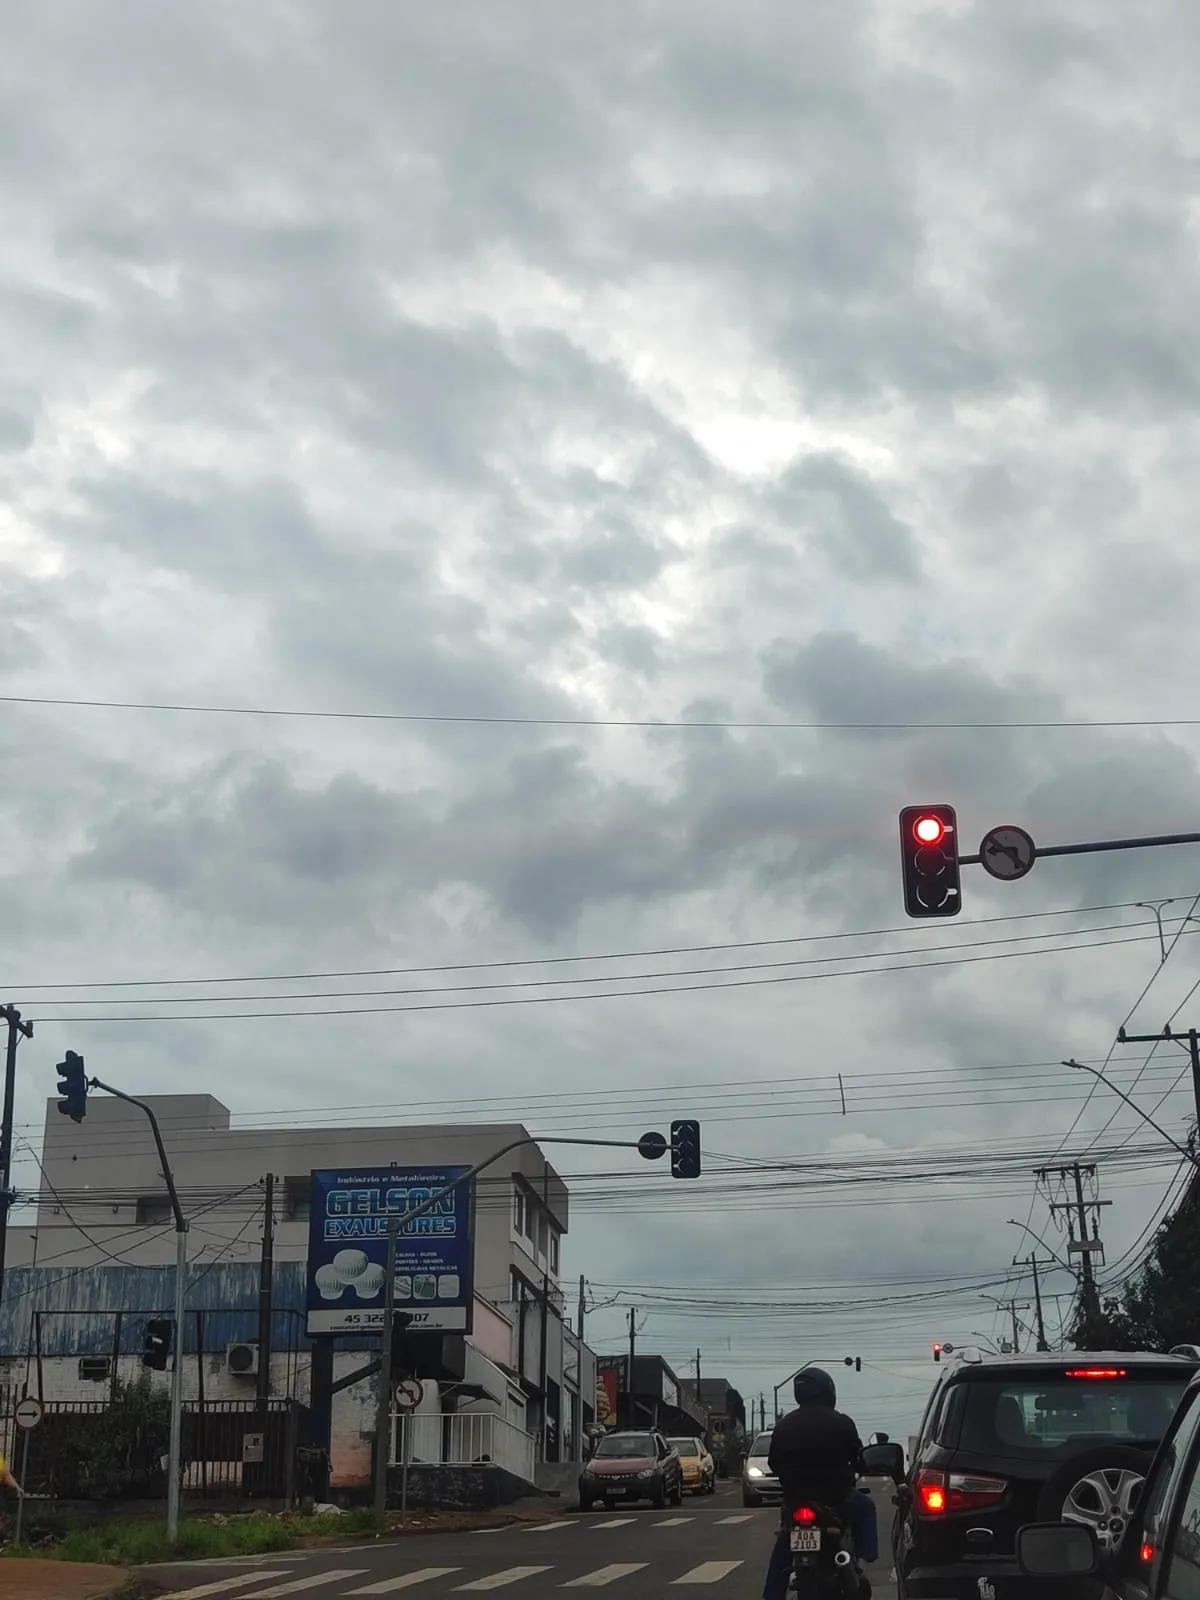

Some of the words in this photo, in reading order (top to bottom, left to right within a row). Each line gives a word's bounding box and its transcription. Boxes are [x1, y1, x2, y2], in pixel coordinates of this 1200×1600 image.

[327, 1187, 456, 1217] GELSON
[323, 1216, 457, 1238] EXAUSORES
[344, 1314, 361, 1323] 45
